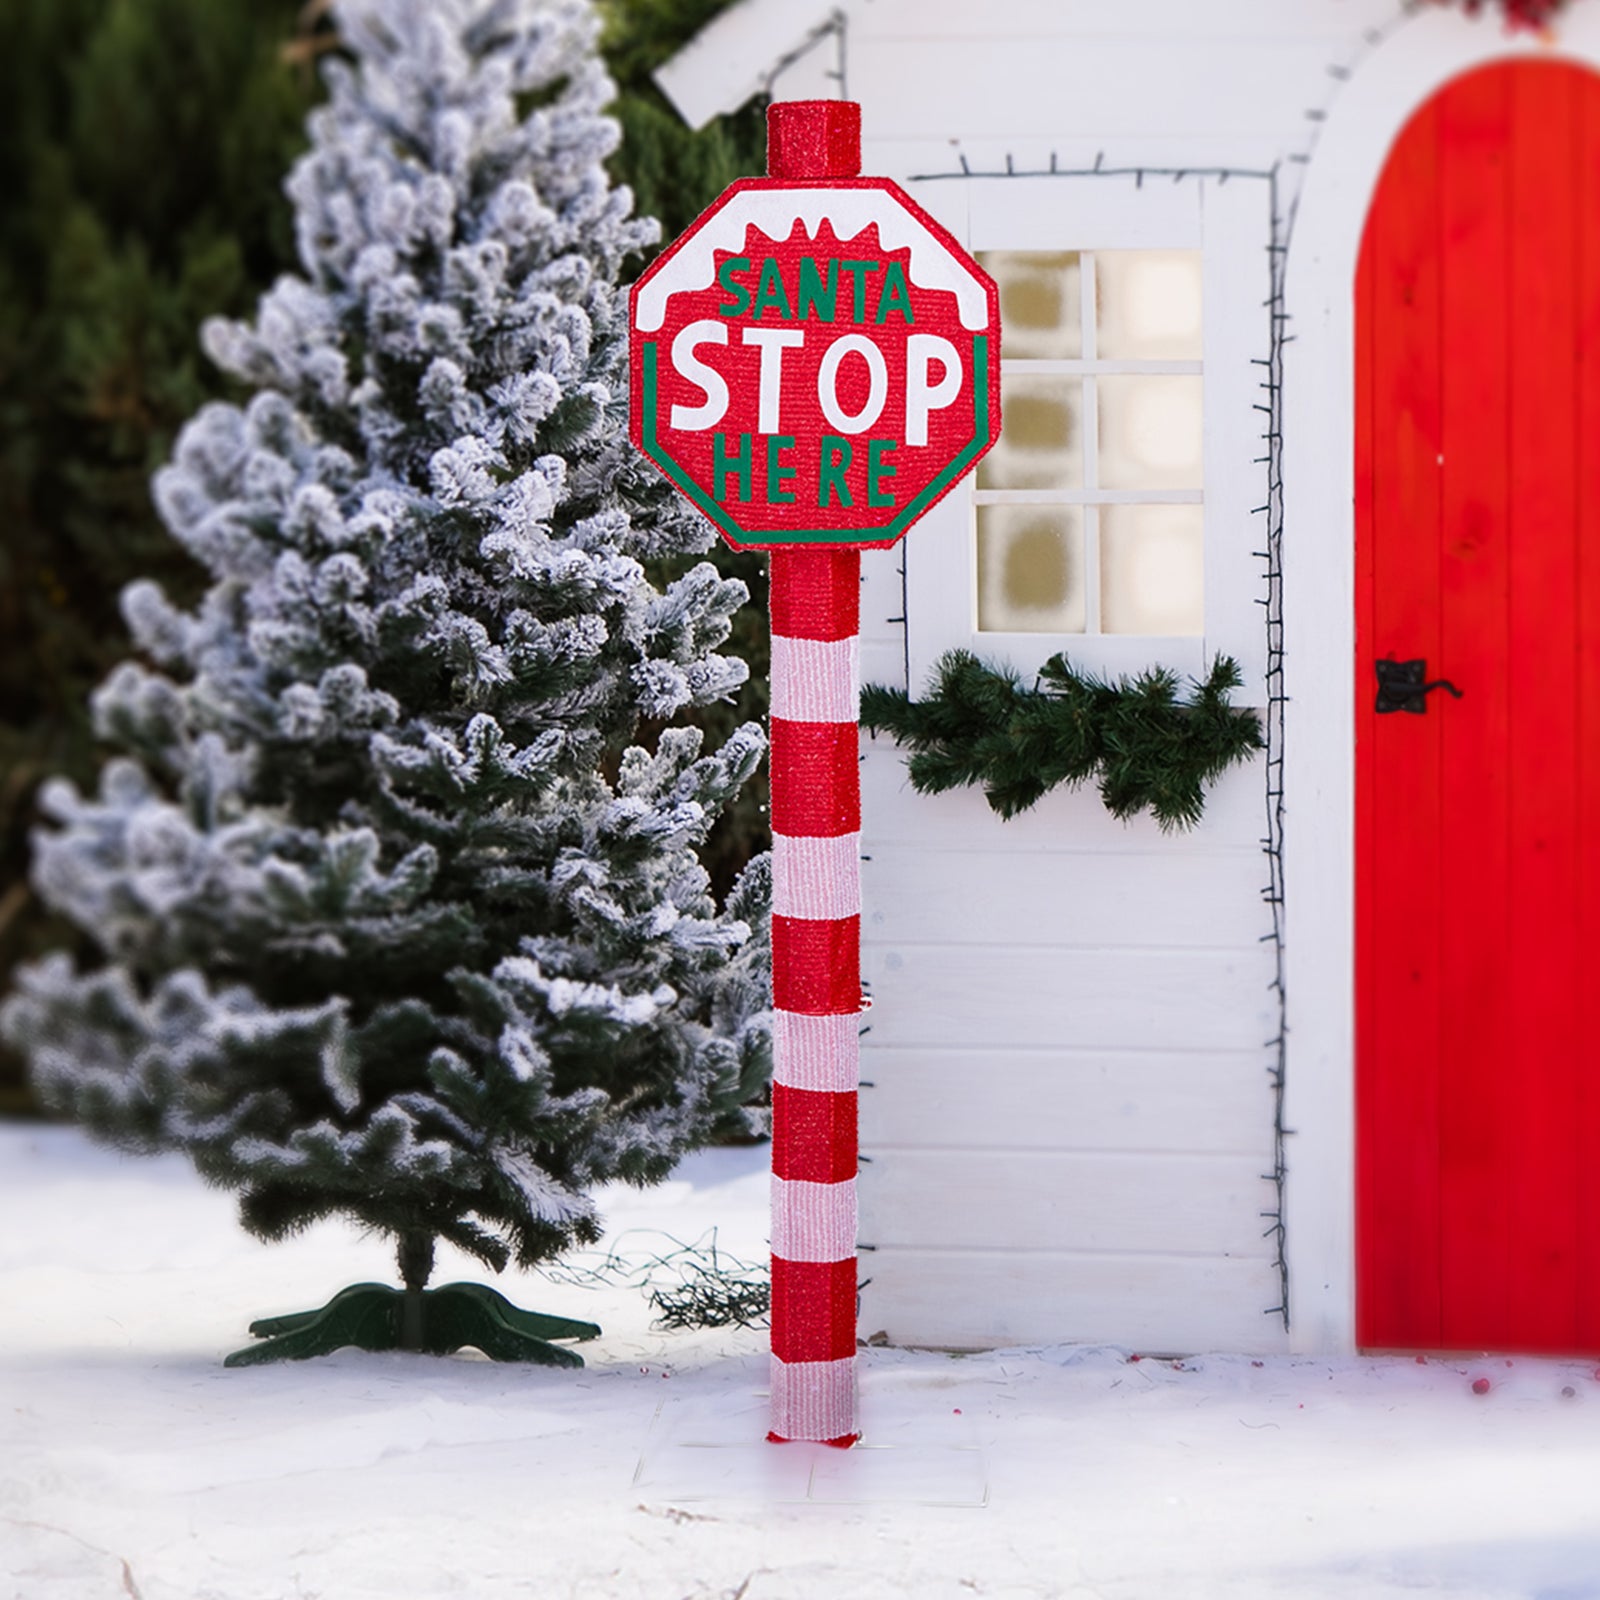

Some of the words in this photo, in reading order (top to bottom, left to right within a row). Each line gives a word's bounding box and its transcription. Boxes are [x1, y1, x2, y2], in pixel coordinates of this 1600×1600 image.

[719, 257, 913, 324] SANTA
[670, 319, 963, 447] STOP
[713, 433, 898, 508] HERE
